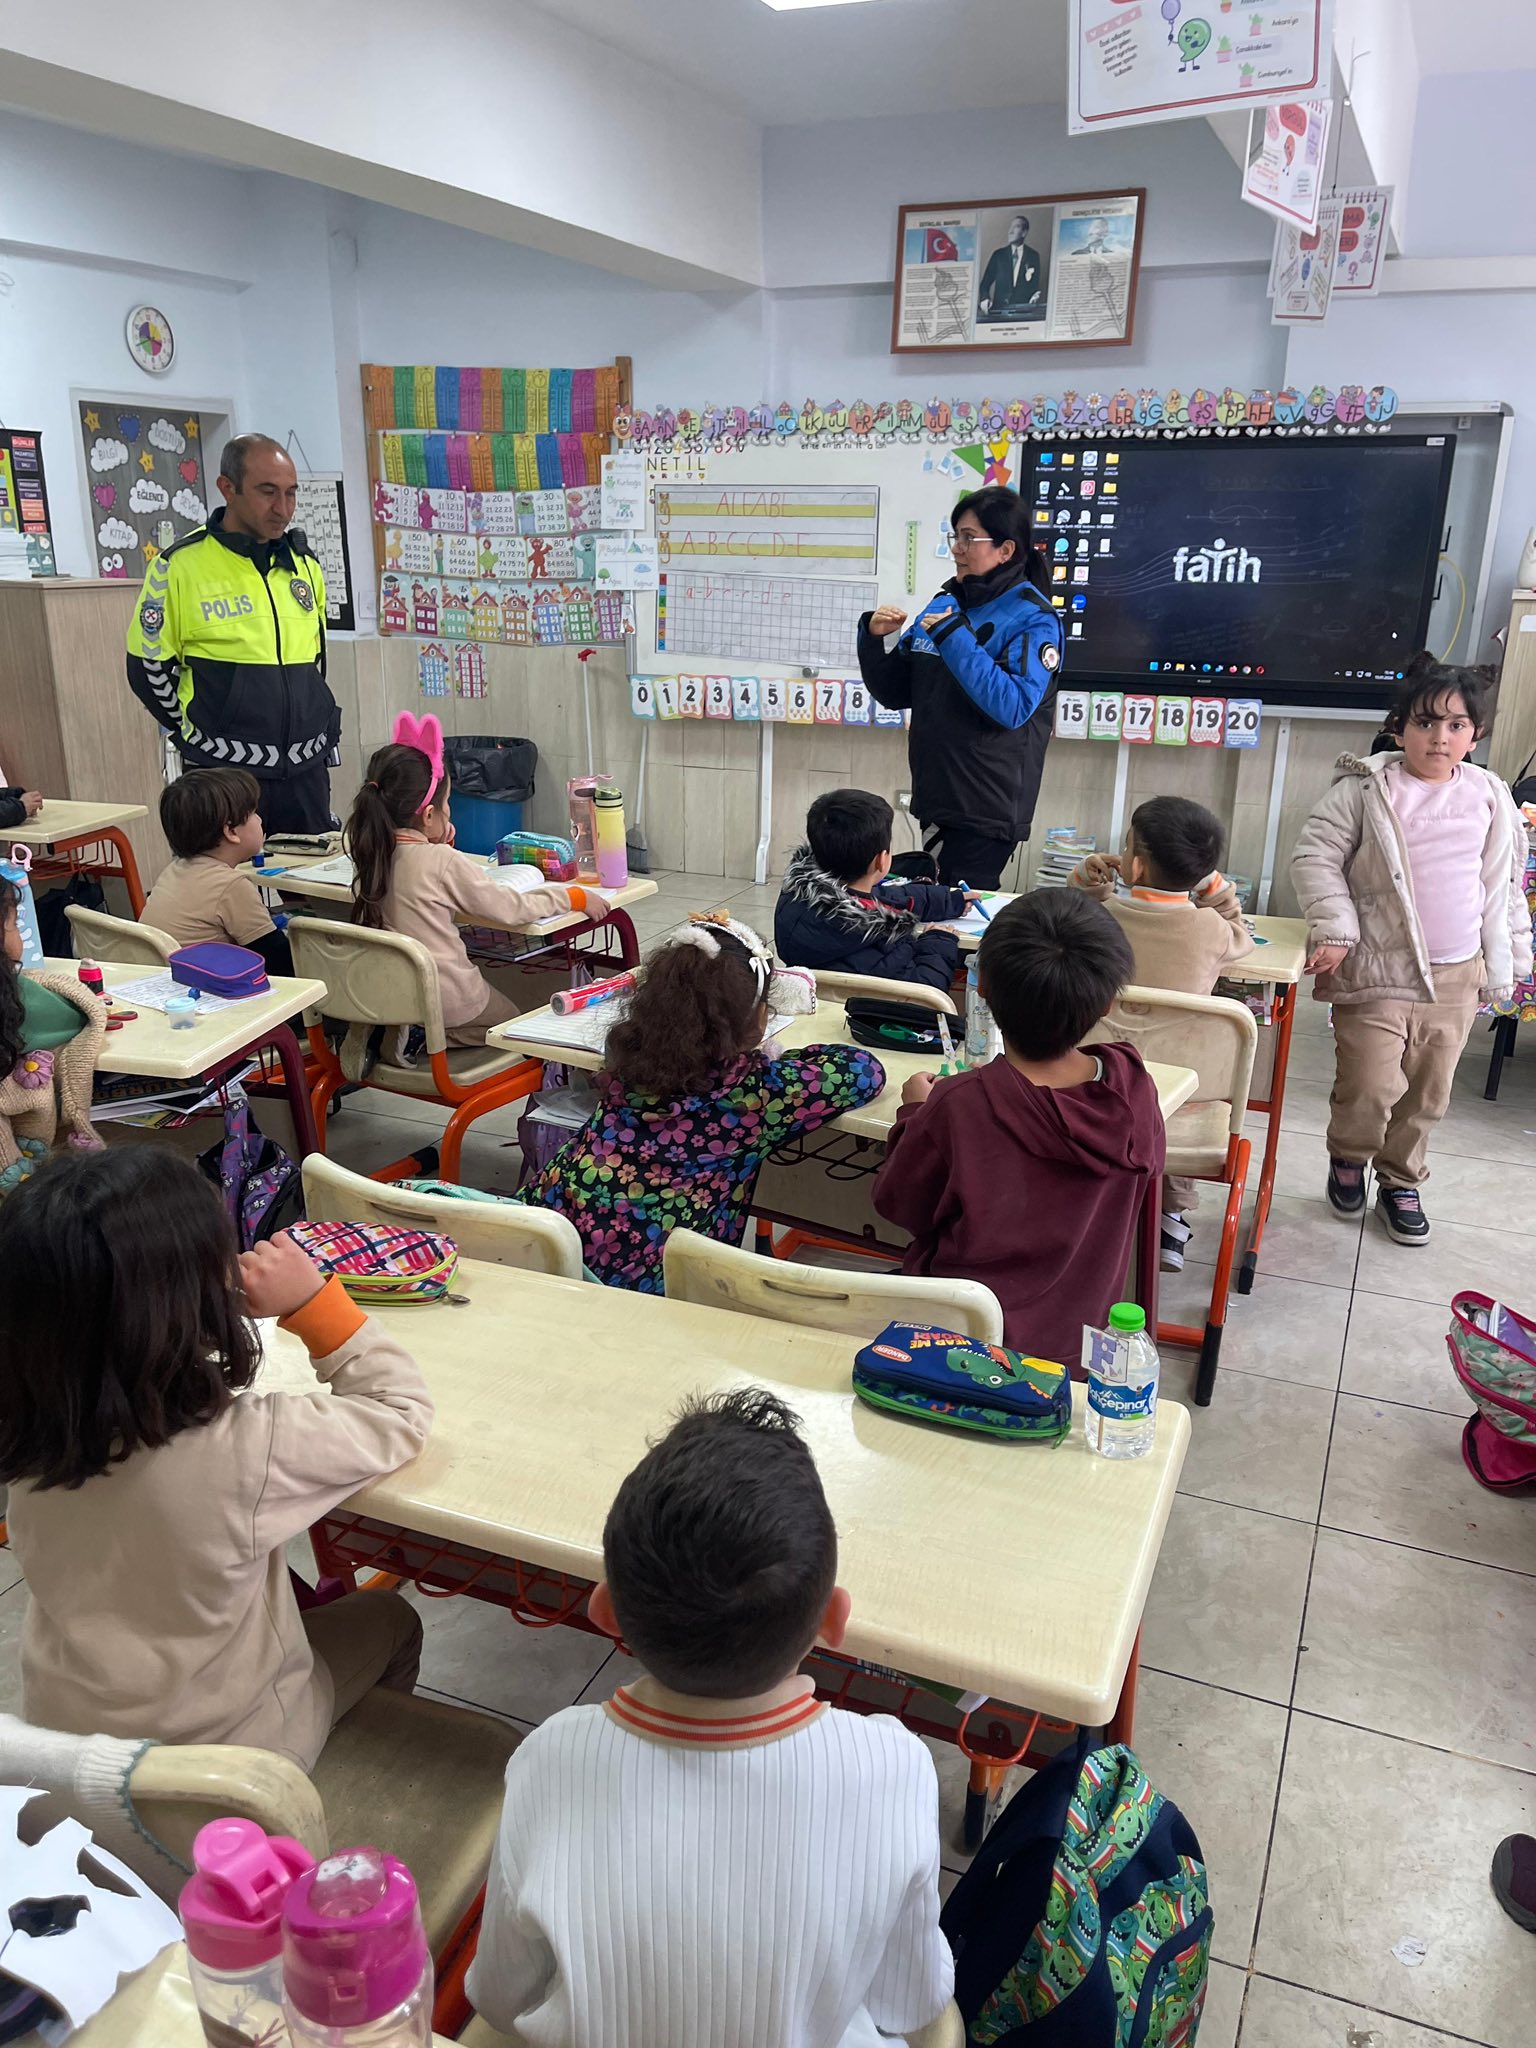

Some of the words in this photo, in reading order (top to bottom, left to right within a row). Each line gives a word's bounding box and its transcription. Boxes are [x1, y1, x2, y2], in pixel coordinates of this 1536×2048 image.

[638, 687, 648, 702] 0
[663, 688, 670, 704] 1
[686, 685, 695, 701] 2
[713, 686, 722, 702] 3
[741, 688, 750, 704] 4
[768, 689, 778, 705] 5
[795, 691, 805, 707] 6
[823, 690, 833, 706] 7
[852, 691, 862, 708] 8
[1061, 703, 1083, 722] 15
[1095, 704, 1117, 722] 16
[1129, 707, 1152, 725] 17
[1161, 708, 1184, 726] 18
[1196, 709, 1220, 727] 19
[1228, 711, 1258, 730] 20
[910, 1340, 931, 1349] ME
